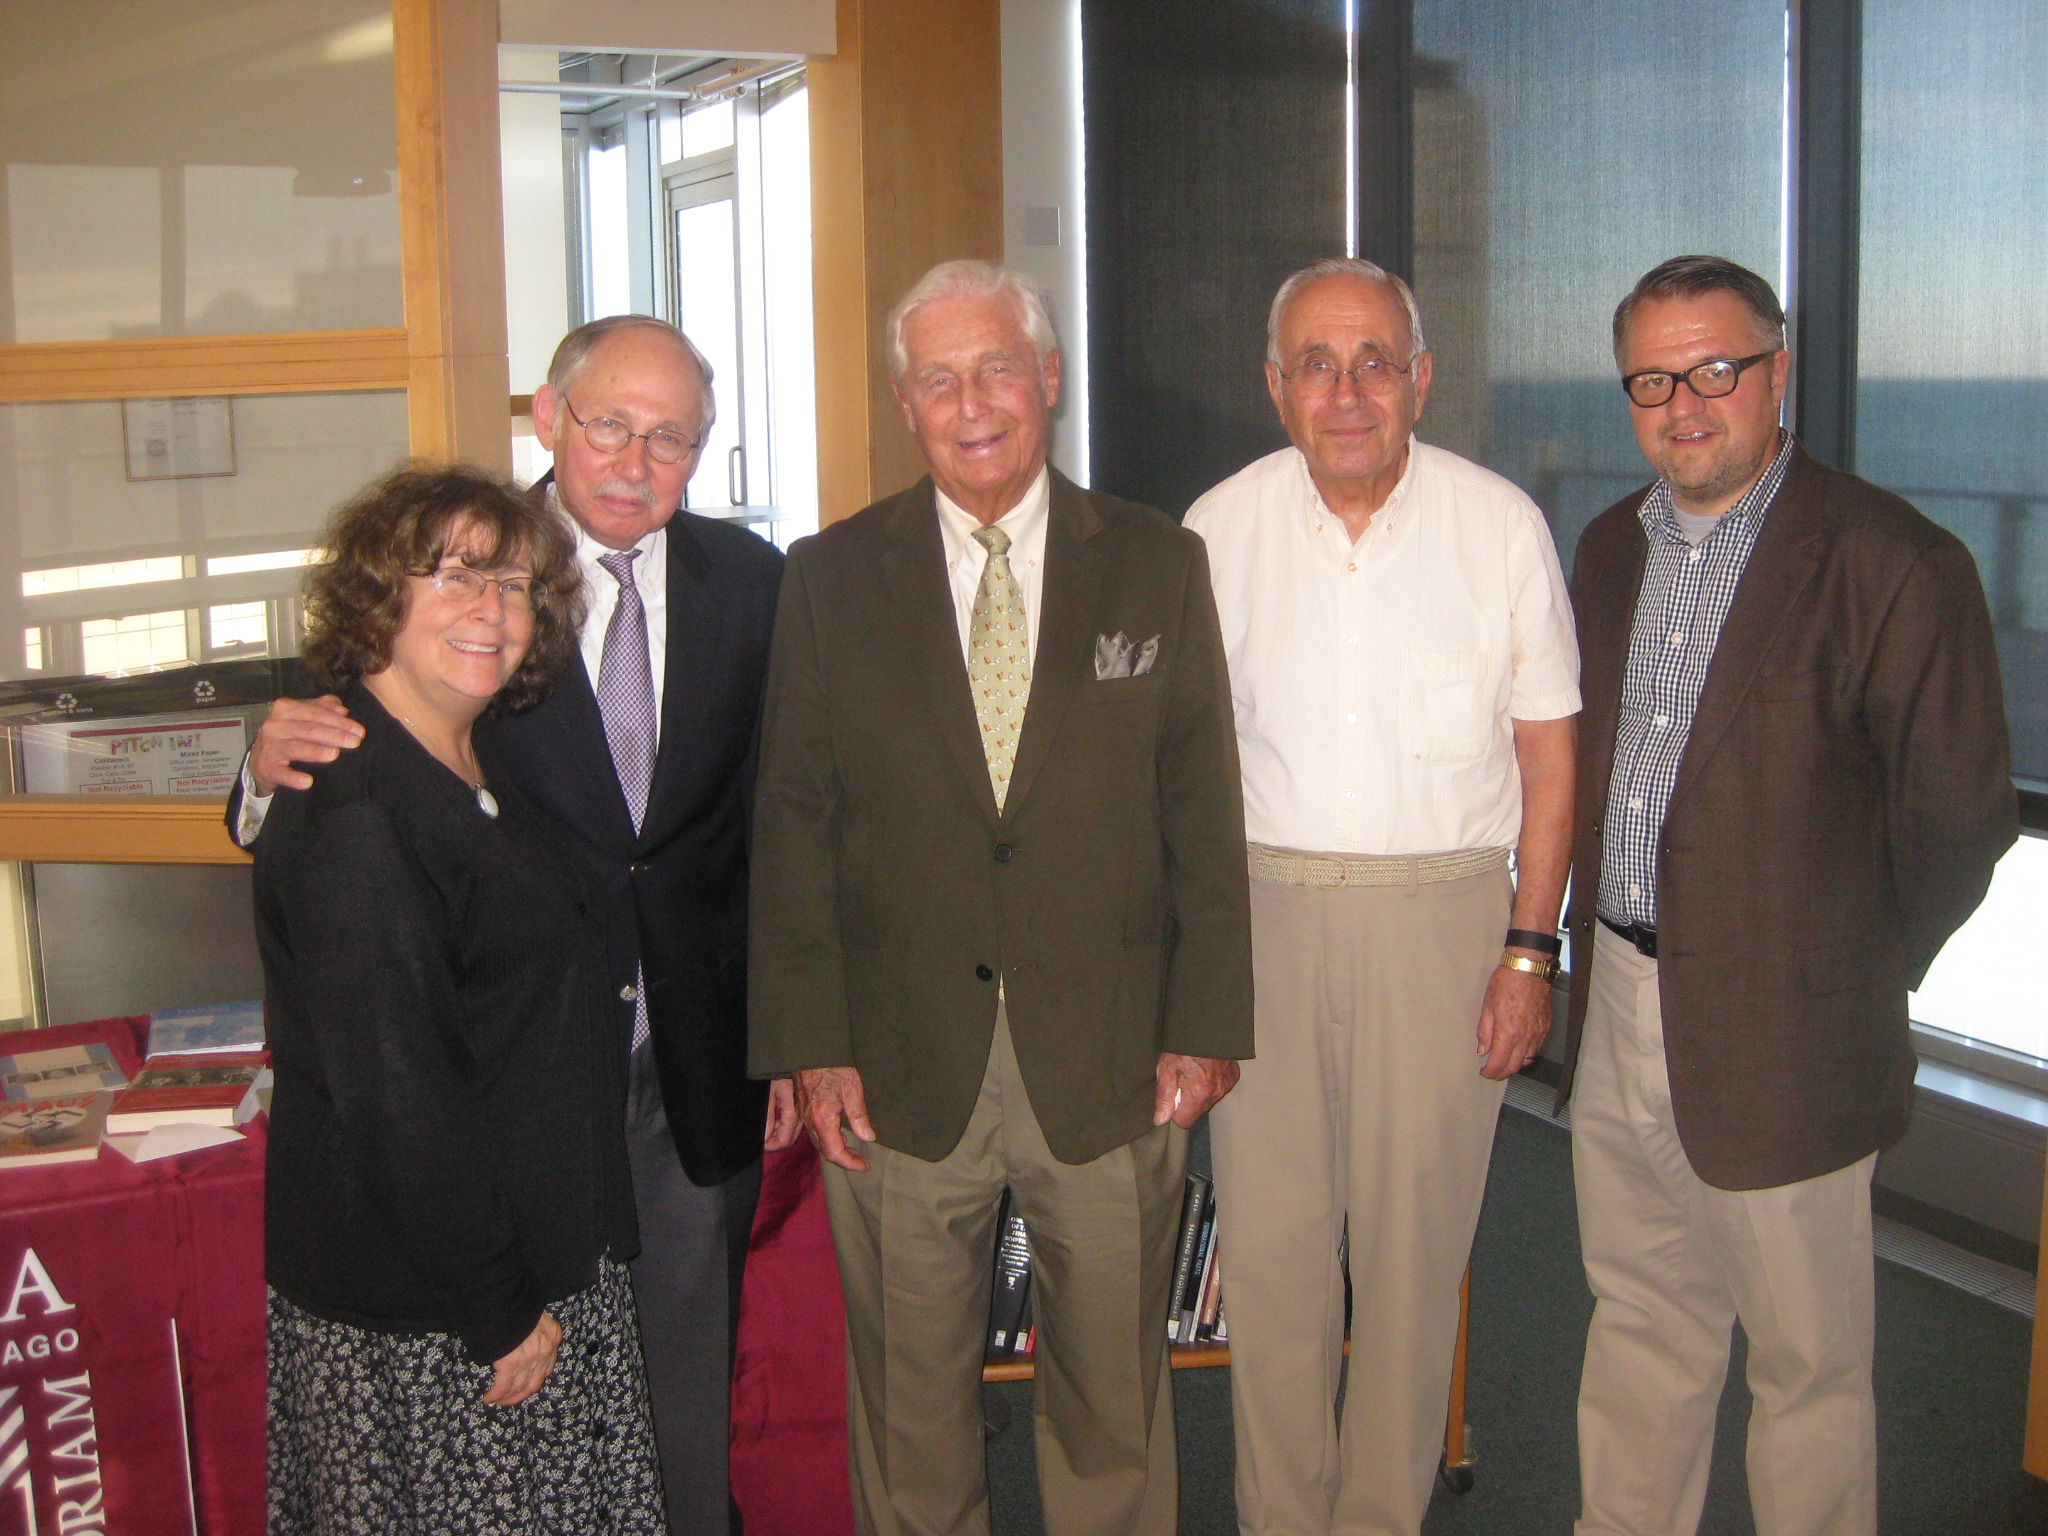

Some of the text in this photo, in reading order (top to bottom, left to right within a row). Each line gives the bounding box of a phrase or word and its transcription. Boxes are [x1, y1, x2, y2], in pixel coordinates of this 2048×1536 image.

[196, 696, 216, 704] paper
[111, 735, 163, 755] PITCH
[103, 784, 144, 793] Recyclable
[192, 777, 231, 785] Recyclable
[0, 1095, 96, 1115] MAUS
[1184, 1223, 1196, 1255] SELLING
[1180, 1256, 1189, 1272] THE
[1172, 1275, 1186, 1320] HOLOCAUST
